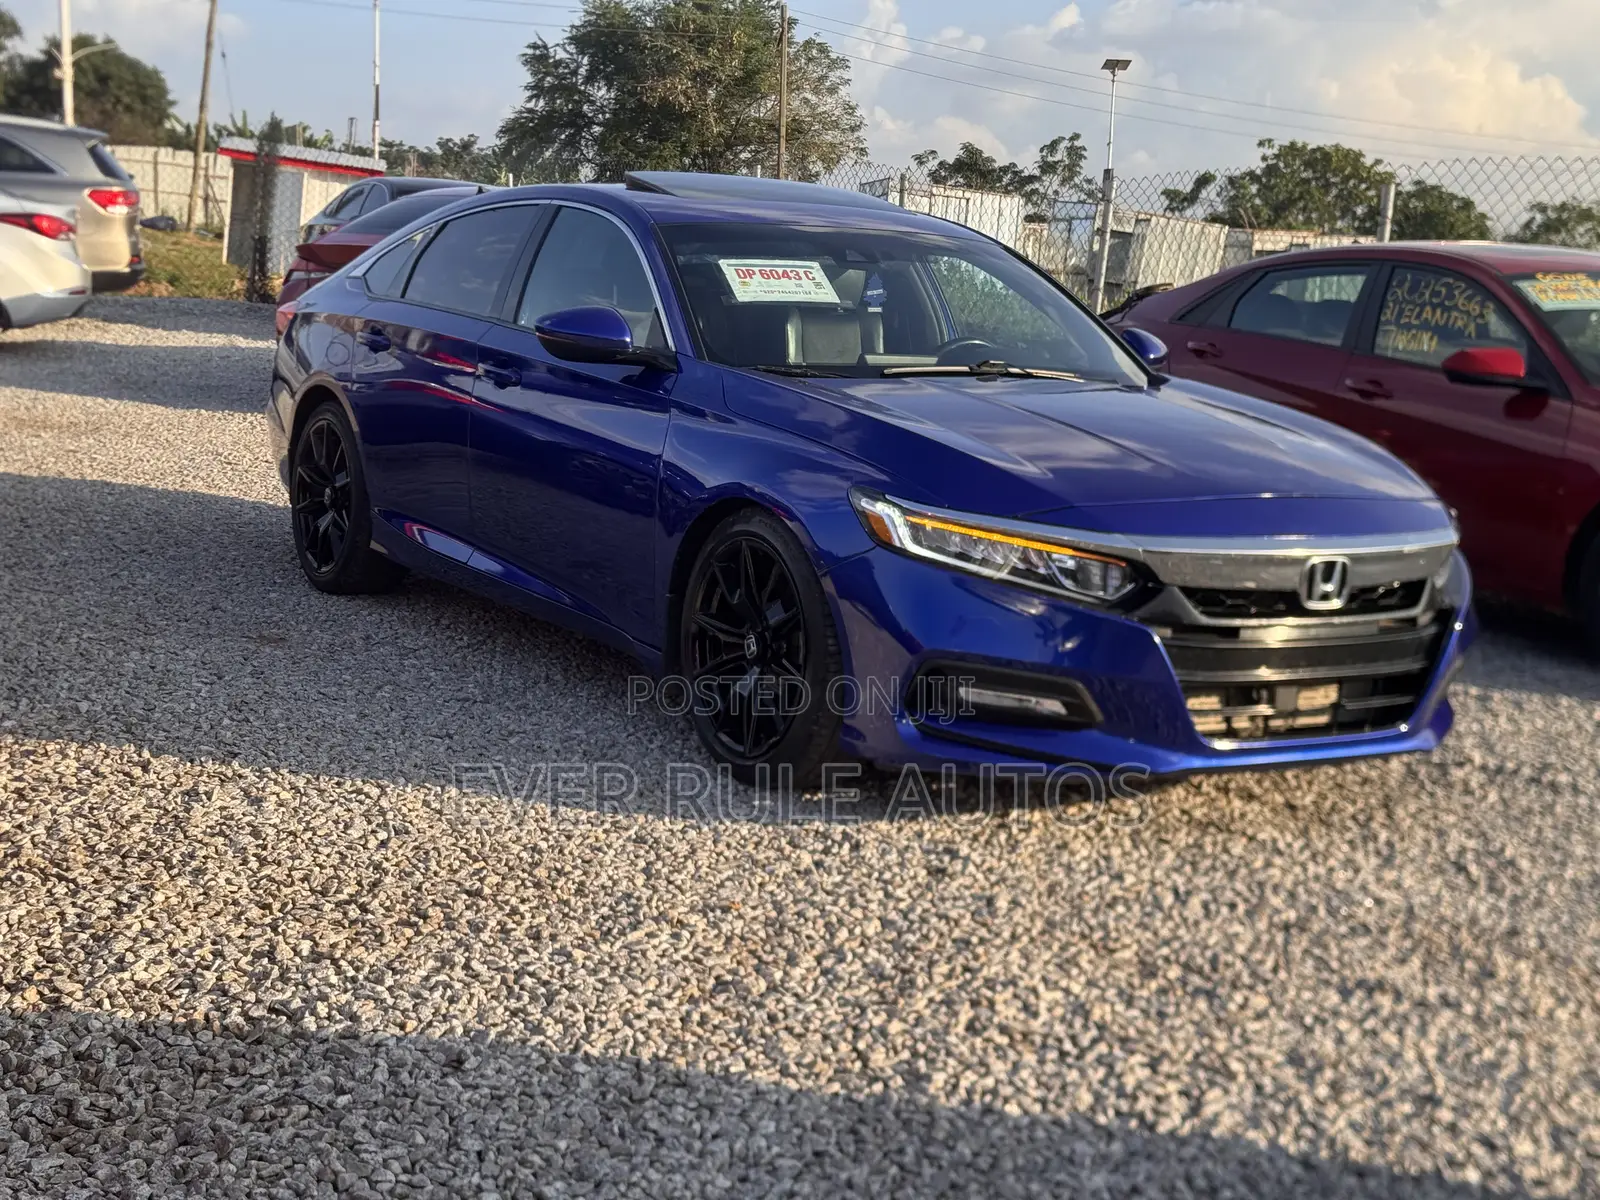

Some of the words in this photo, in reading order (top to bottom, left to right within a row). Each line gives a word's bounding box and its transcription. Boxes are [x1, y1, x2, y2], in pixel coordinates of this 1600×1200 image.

[734, 268, 756, 280] DP
[759, 269, 802, 281] 6043
[804, 270, 816, 281] C
